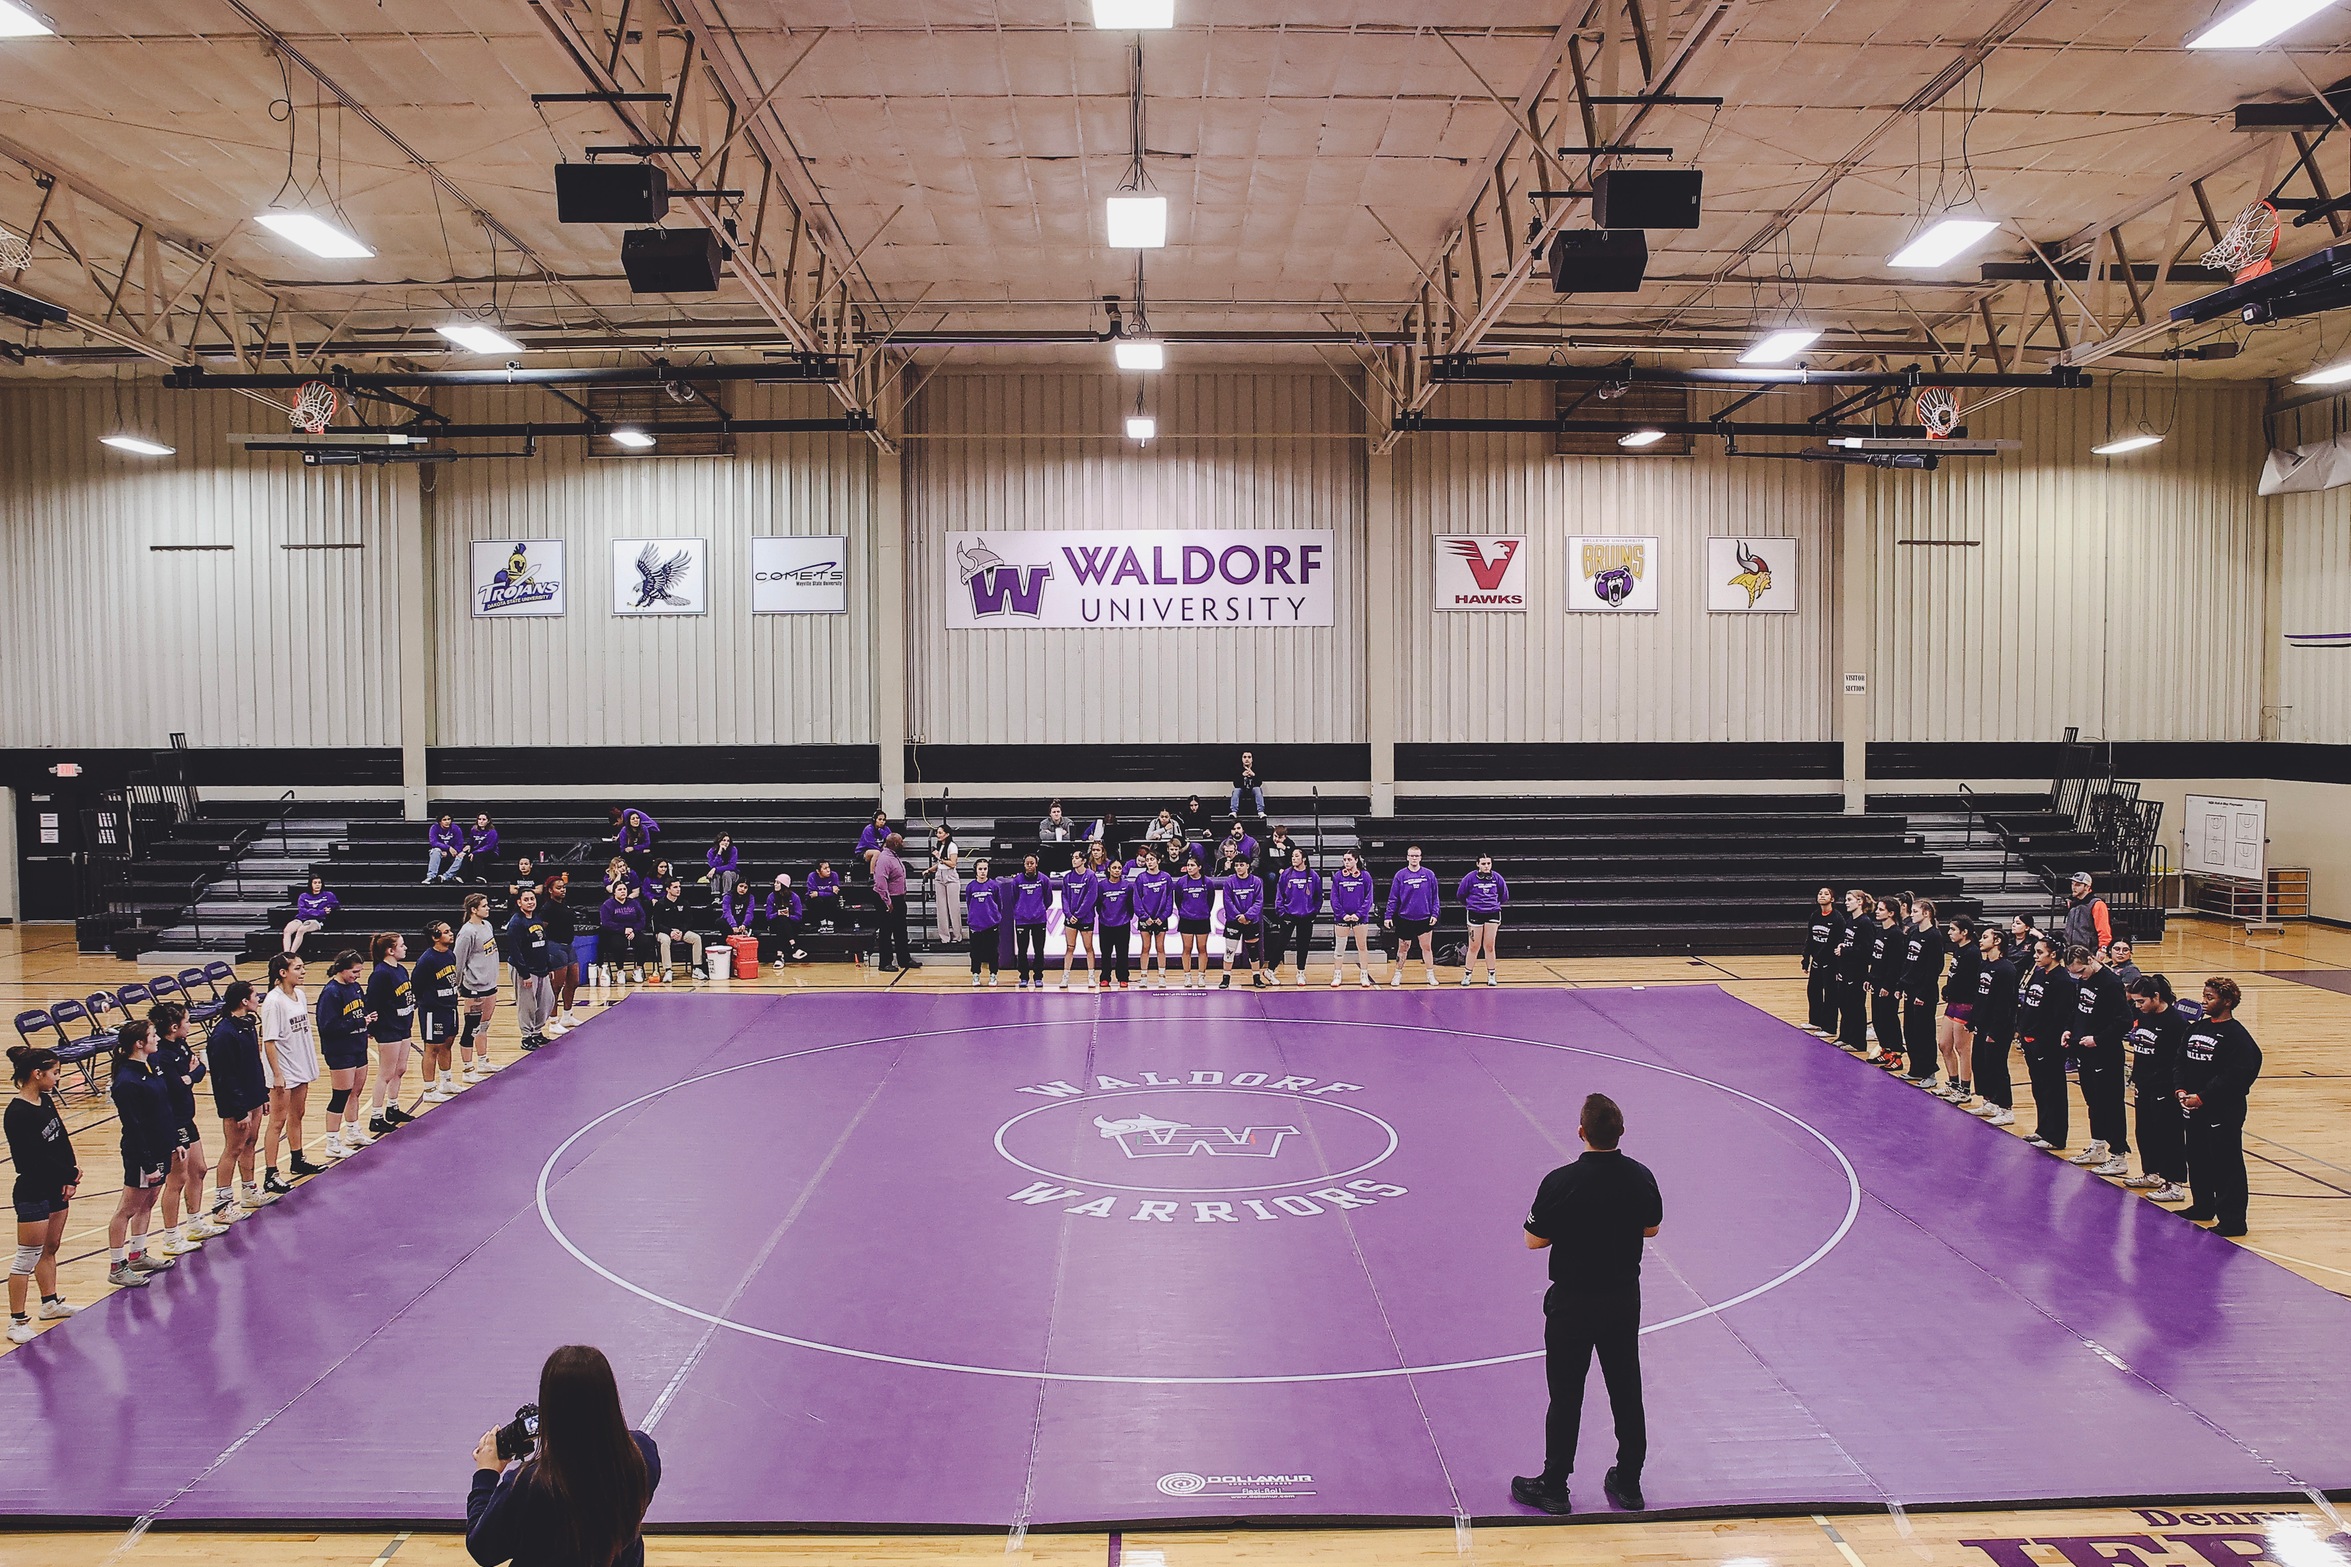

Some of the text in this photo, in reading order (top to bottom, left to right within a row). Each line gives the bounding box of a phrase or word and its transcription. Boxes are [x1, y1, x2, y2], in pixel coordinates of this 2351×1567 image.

[1061, 545, 1323, 586] WALDORF
[1582, 543, 1645, 581] BRUINS
[755, 571, 843, 581] COMETS
[478, 581, 560, 604] TROJANS
[487, 600, 506, 609] DAKOTA
[1454, 594, 1523, 605] HAWKS
[1081, 597, 1307, 622] UNIVERSITY
[1015, 1070, 1365, 1098] WALDORF
[1006, 1178, 1409, 1223] WARRIORS
[1207, 1474, 1315, 1483] DOLLAMUR
